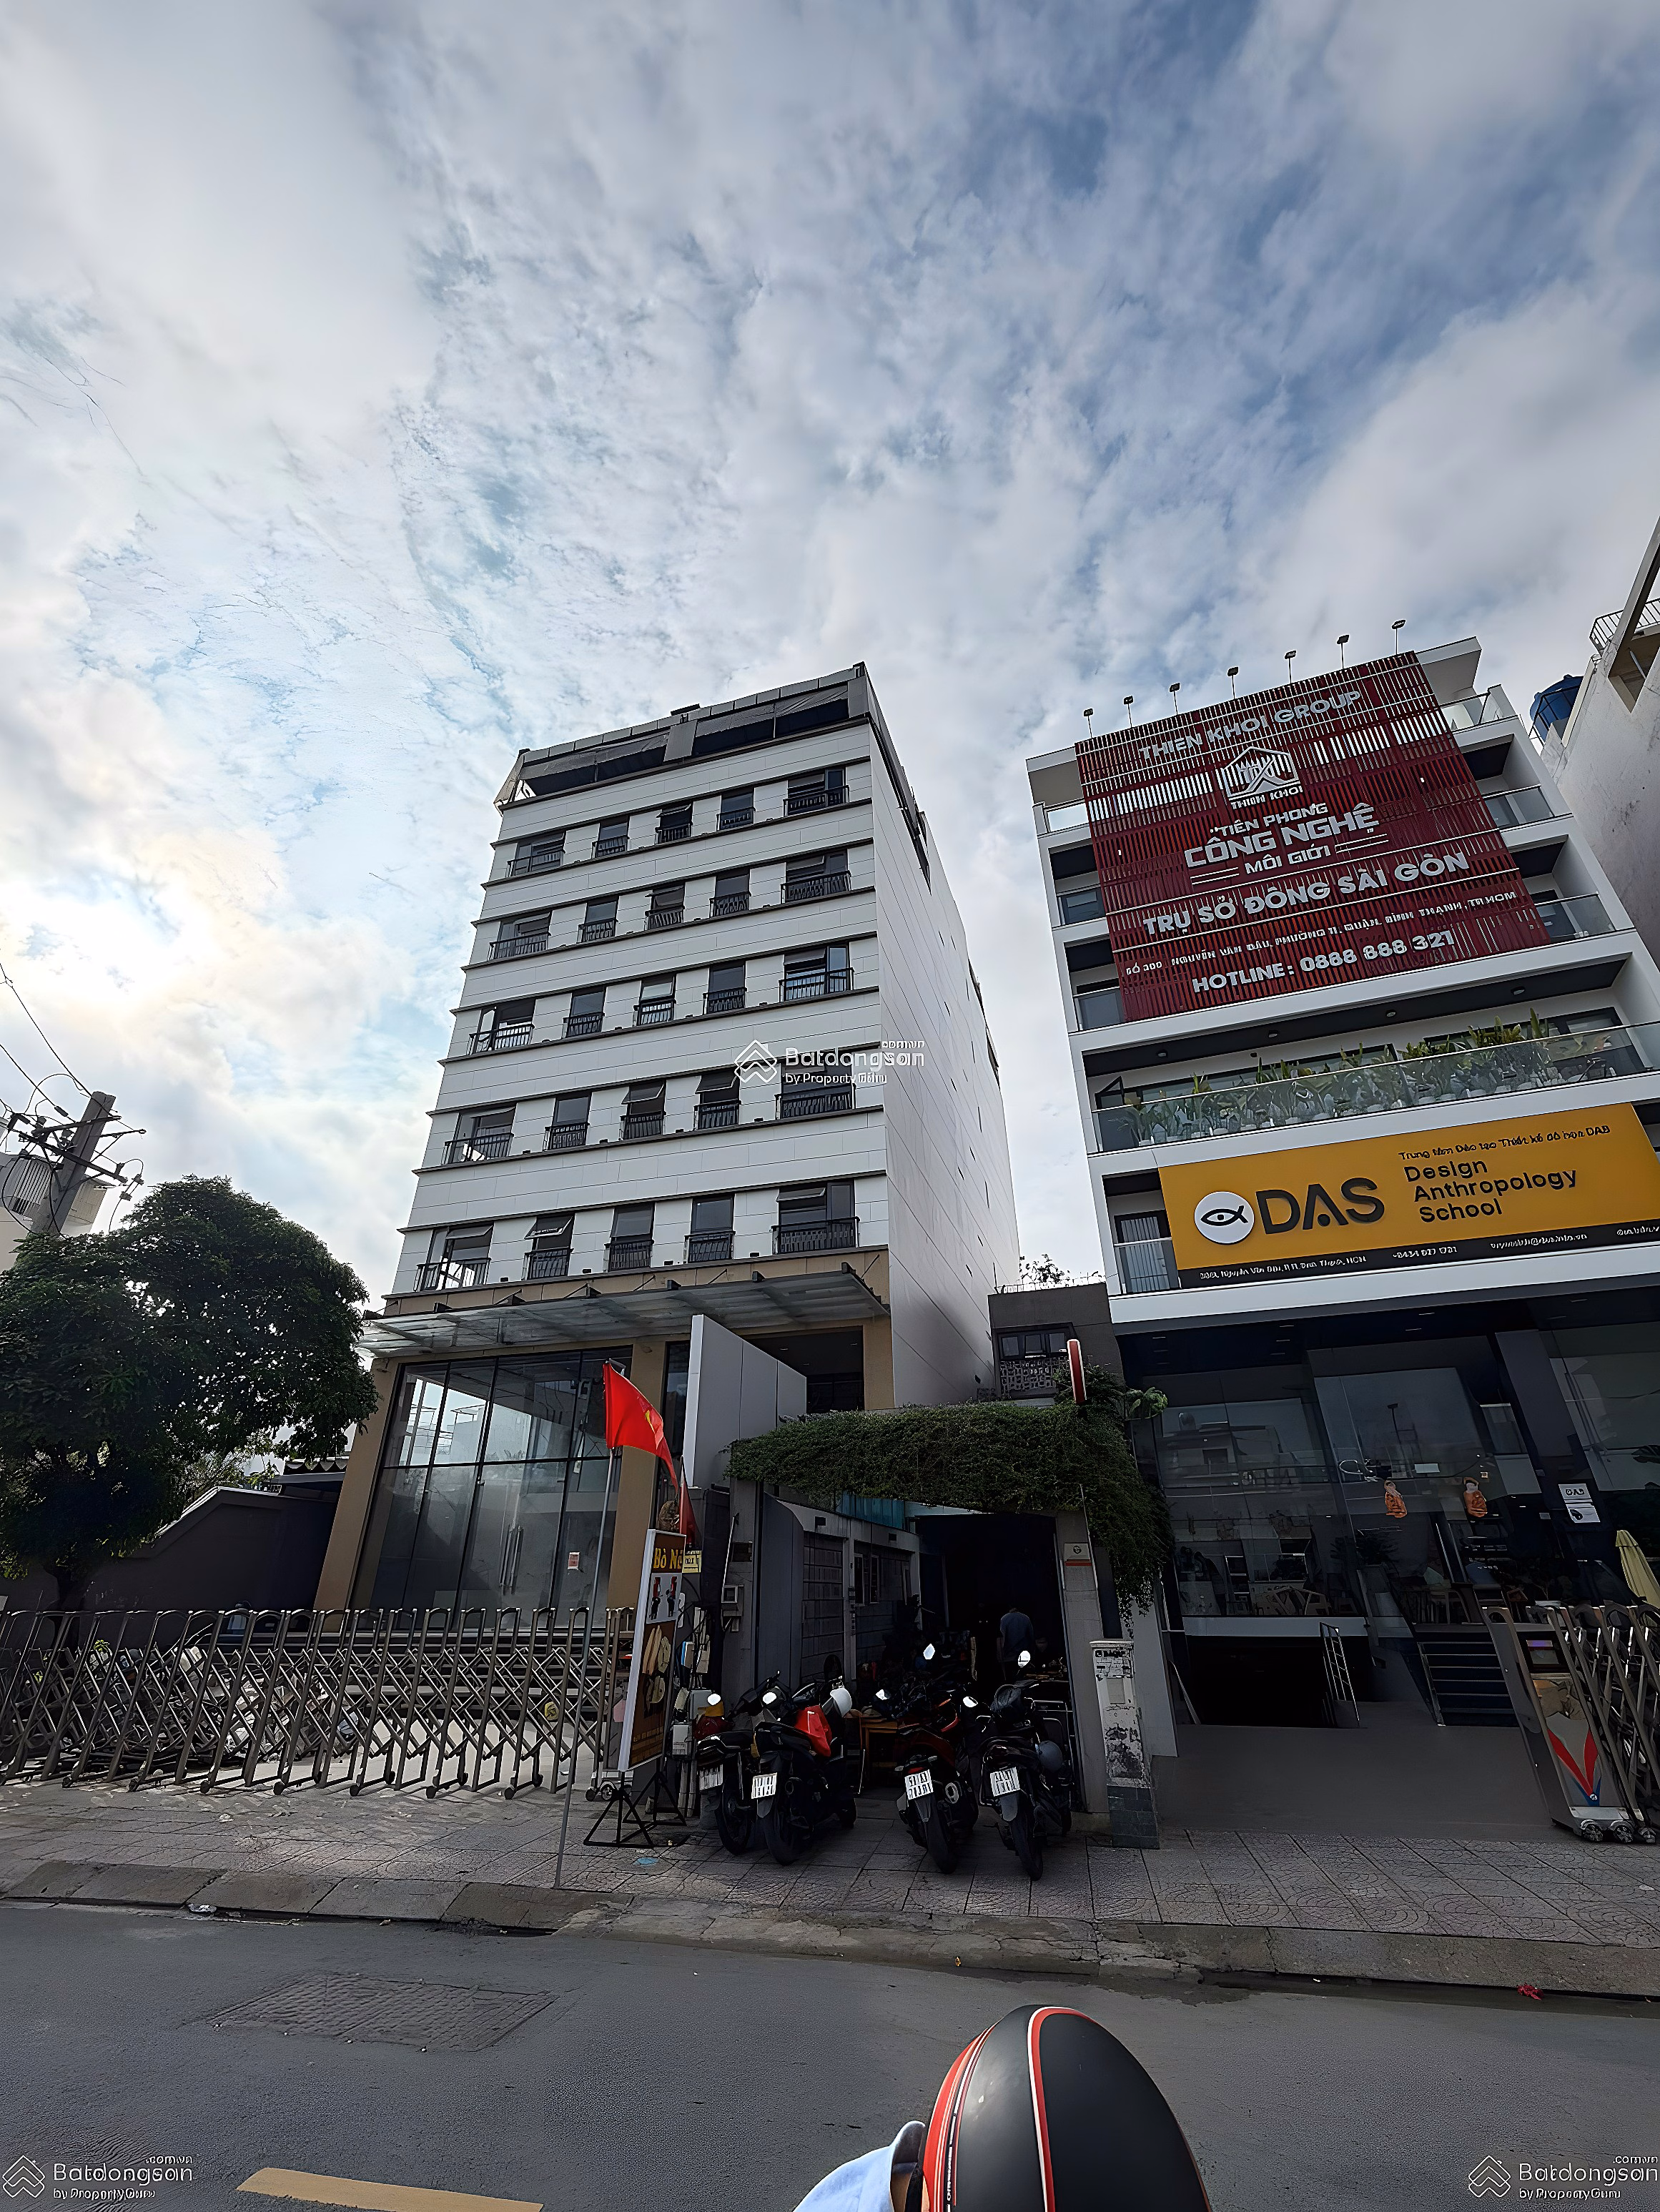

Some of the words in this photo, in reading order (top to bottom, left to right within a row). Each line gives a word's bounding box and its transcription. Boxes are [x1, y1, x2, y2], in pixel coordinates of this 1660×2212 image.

[1274, 691, 1360, 723] GROUP
[1185, 831, 1277, 867] CÔNG
[1245, 854, 1283, 874] MÔI
[1288, 844, 1331, 864] GIỚI
[1143, 910, 1190, 935] TRỤ
[1198, 895, 1236, 923] SỞ
[1245, 882, 1330, 915] ĐÔNG
[1338, 868, 1388, 894] SÀI
[1394, 852, 1470, 882] GÒN
[1300, 949, 1357, 972] 0888
[1363, 939, 1408, 961] 888
[1412, 930, 1455, 950] 321
[1403, 1160, 1488, 1182] Design
[1414, 1169, 1577, 1202] Anthropology
[1255, 1177, 1385, 1235] DAS
[1418, 1198, 1503, 1223] School
